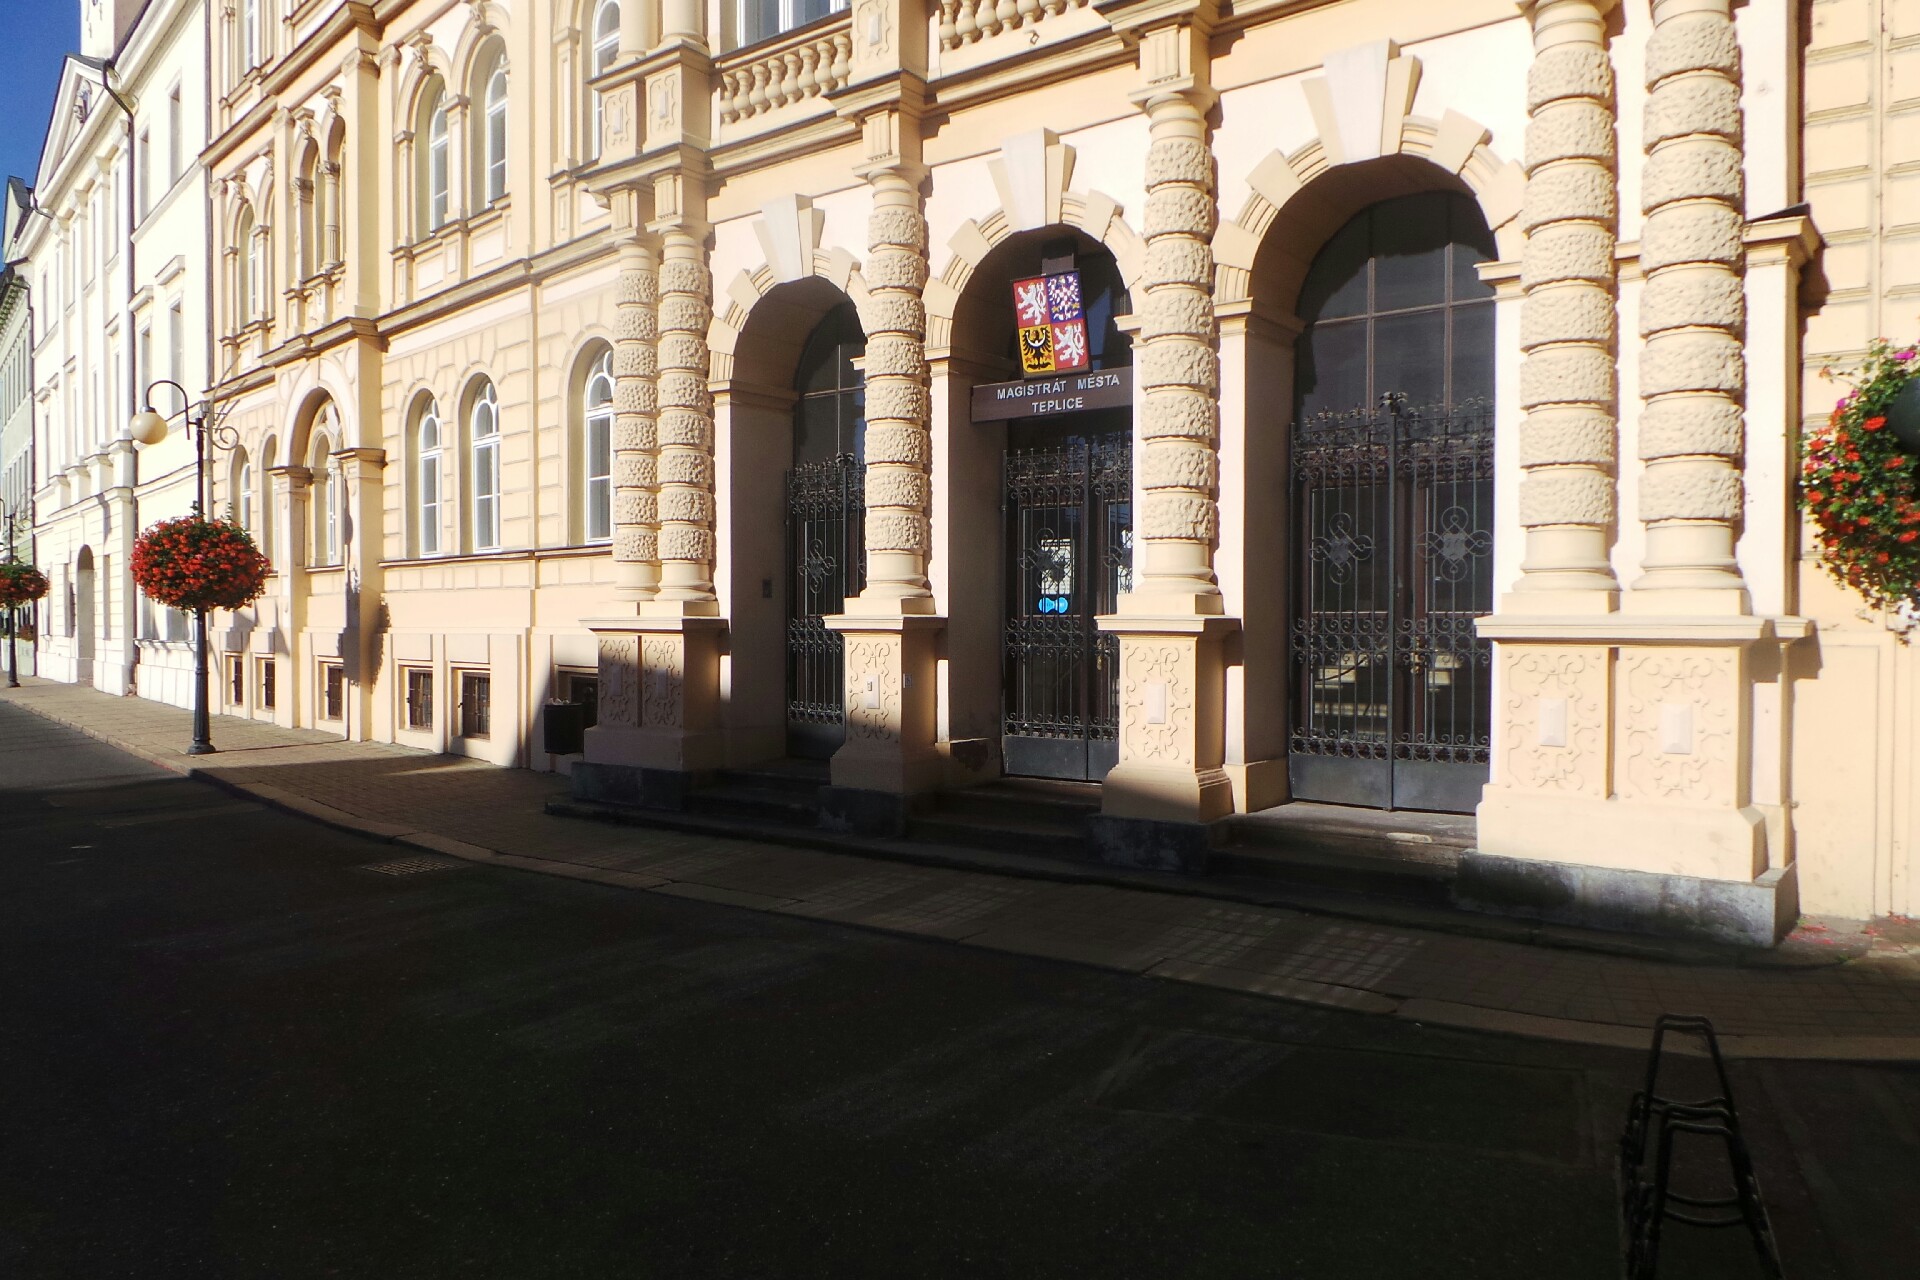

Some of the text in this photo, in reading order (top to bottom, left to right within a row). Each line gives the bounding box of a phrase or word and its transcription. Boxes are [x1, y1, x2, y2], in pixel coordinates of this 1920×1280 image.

[997, 373, 1120, 400] MAGISTRÁT MĚSTA
[1032, 397, 1083, 413] TEPLICE
